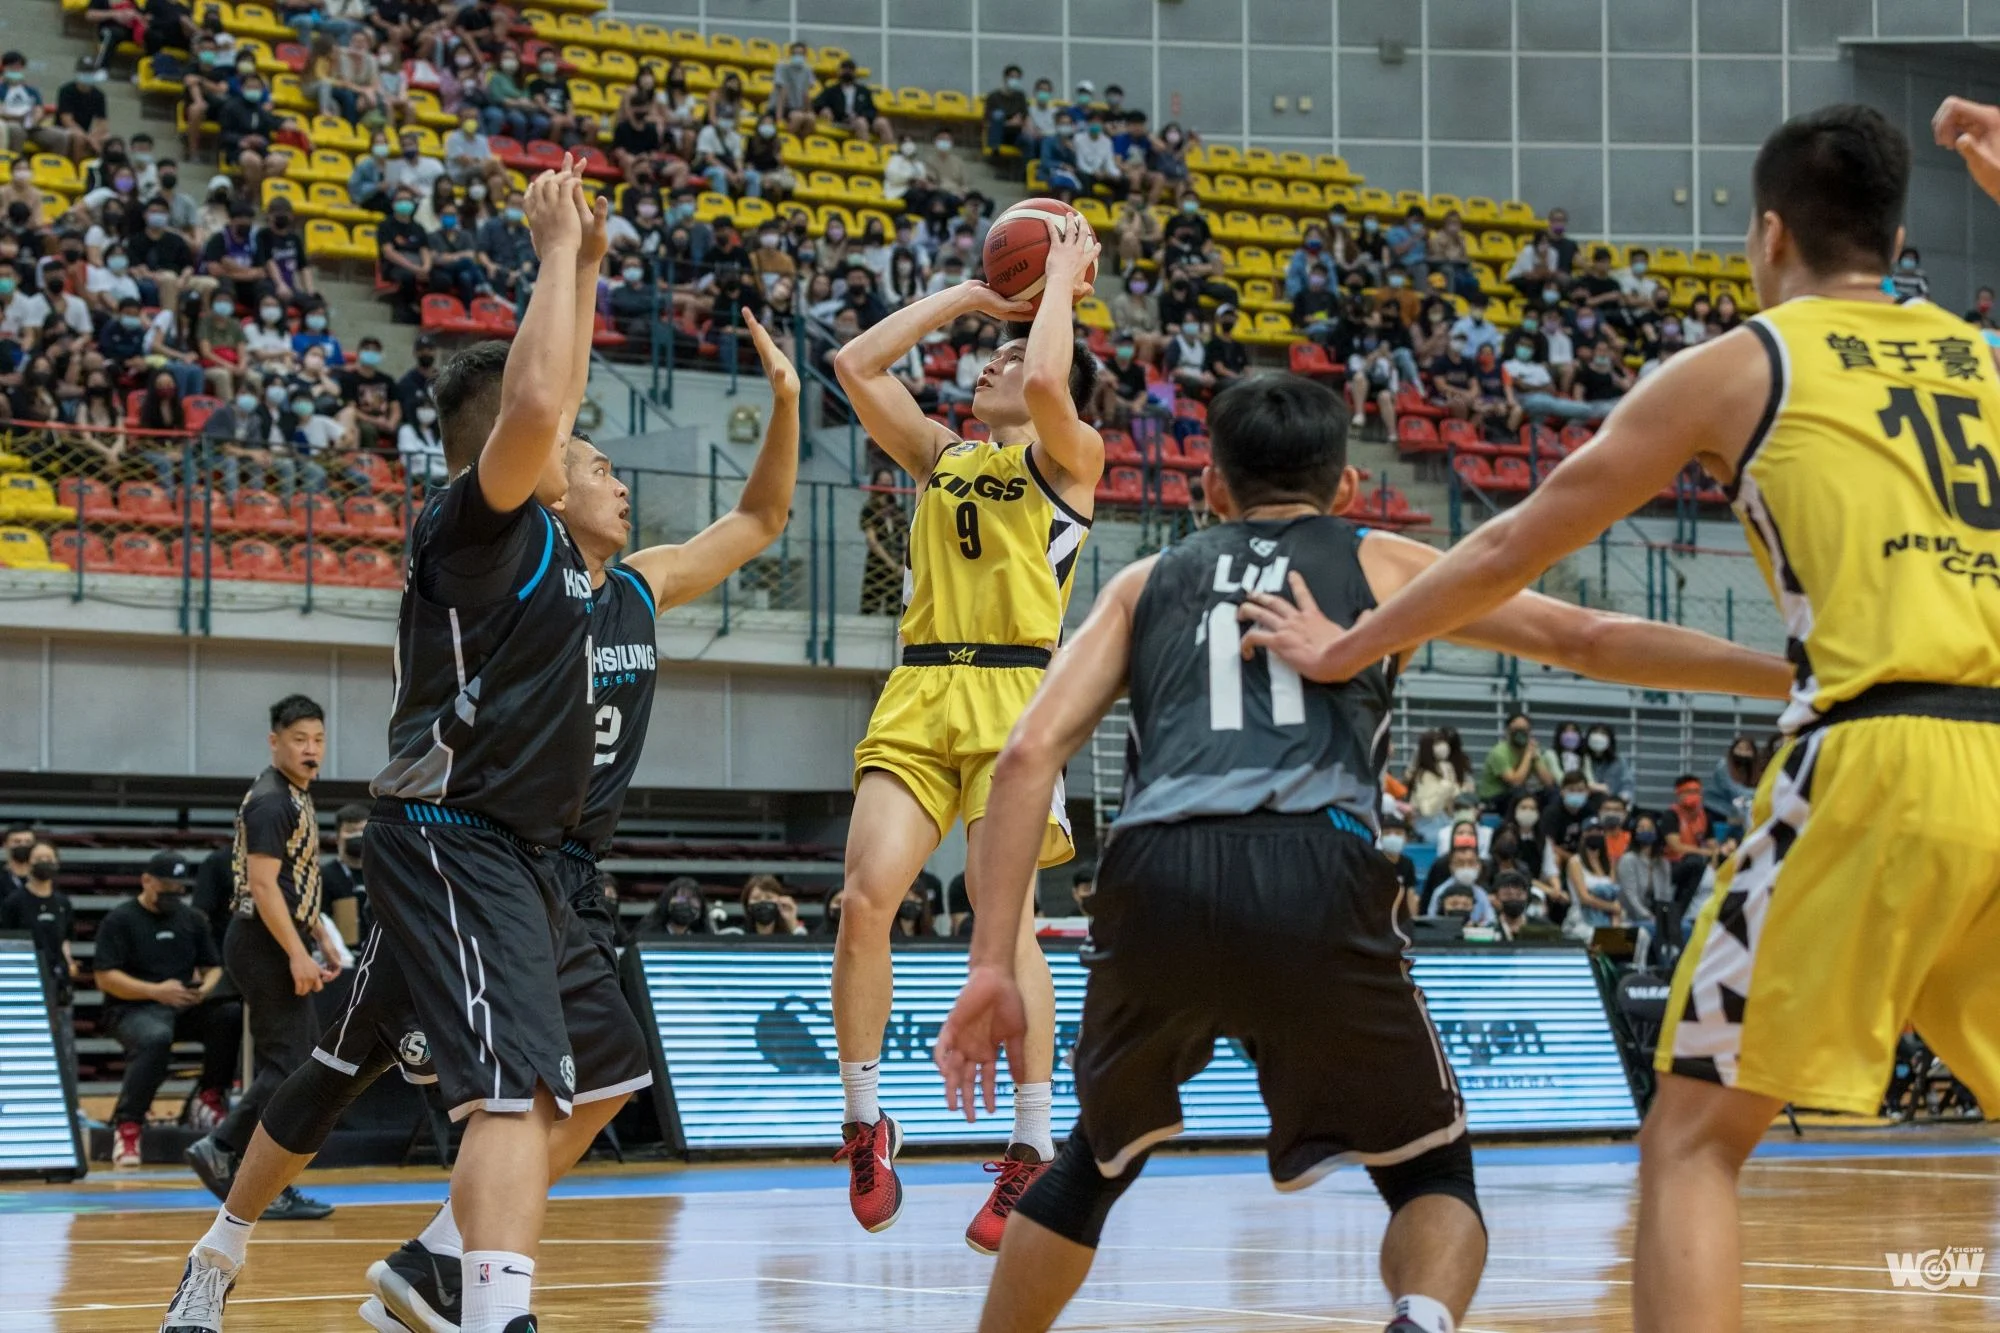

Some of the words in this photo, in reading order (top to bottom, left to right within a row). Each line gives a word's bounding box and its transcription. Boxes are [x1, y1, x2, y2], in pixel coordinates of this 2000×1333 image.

[1877, 387, 2000, 531] 15
[956, 501, 982, 560] 9
[1195, 601, 1306, 731] 11
